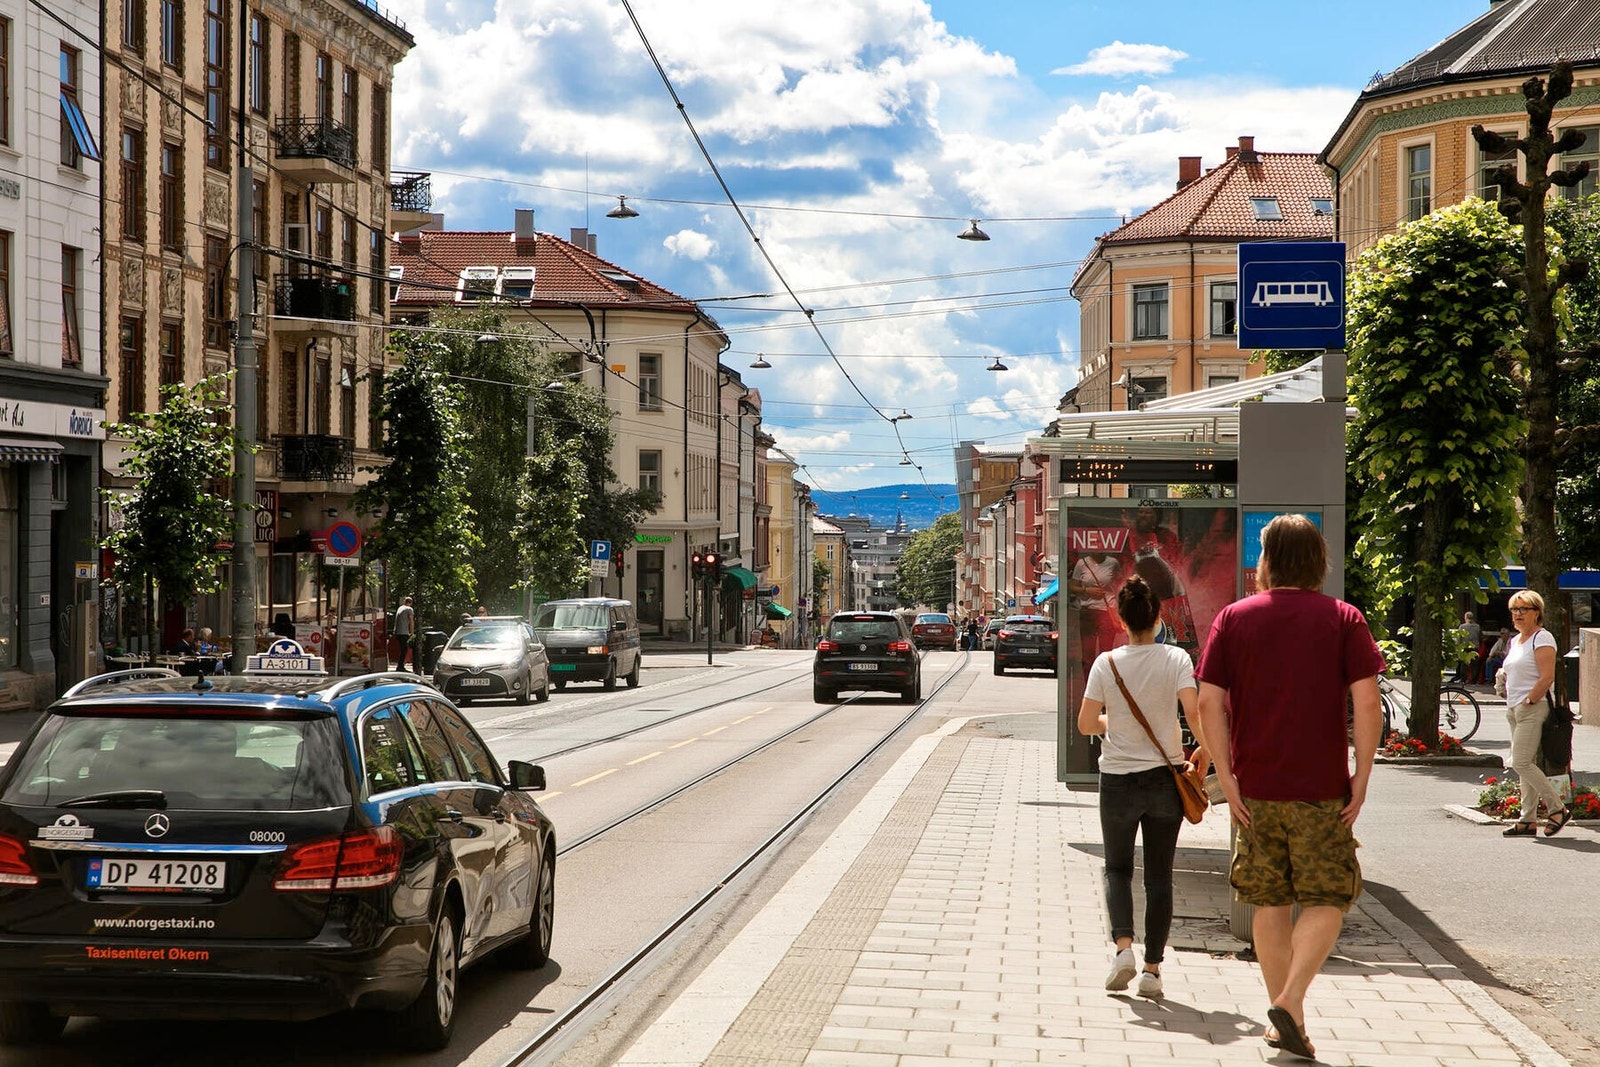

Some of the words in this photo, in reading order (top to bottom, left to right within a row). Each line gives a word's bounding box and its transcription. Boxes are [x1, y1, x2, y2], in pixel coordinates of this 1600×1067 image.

[1137, 499, 1179, 507] JCDecaux
[1073, 530, 1121, 549] NEW
[596, 543, 606, 557] P
[266, 659, 305, 670] A-3101
[249, 830, 286, 842] 08000
[107, 862, 138, 883] DP
[148, 863, 218, 885] 41208
[94, 917, 215, 931] www.norgestaxi.no
[85, 946, 165, 960] Taxisenteret
[168, 947, 210, 961] Økern
